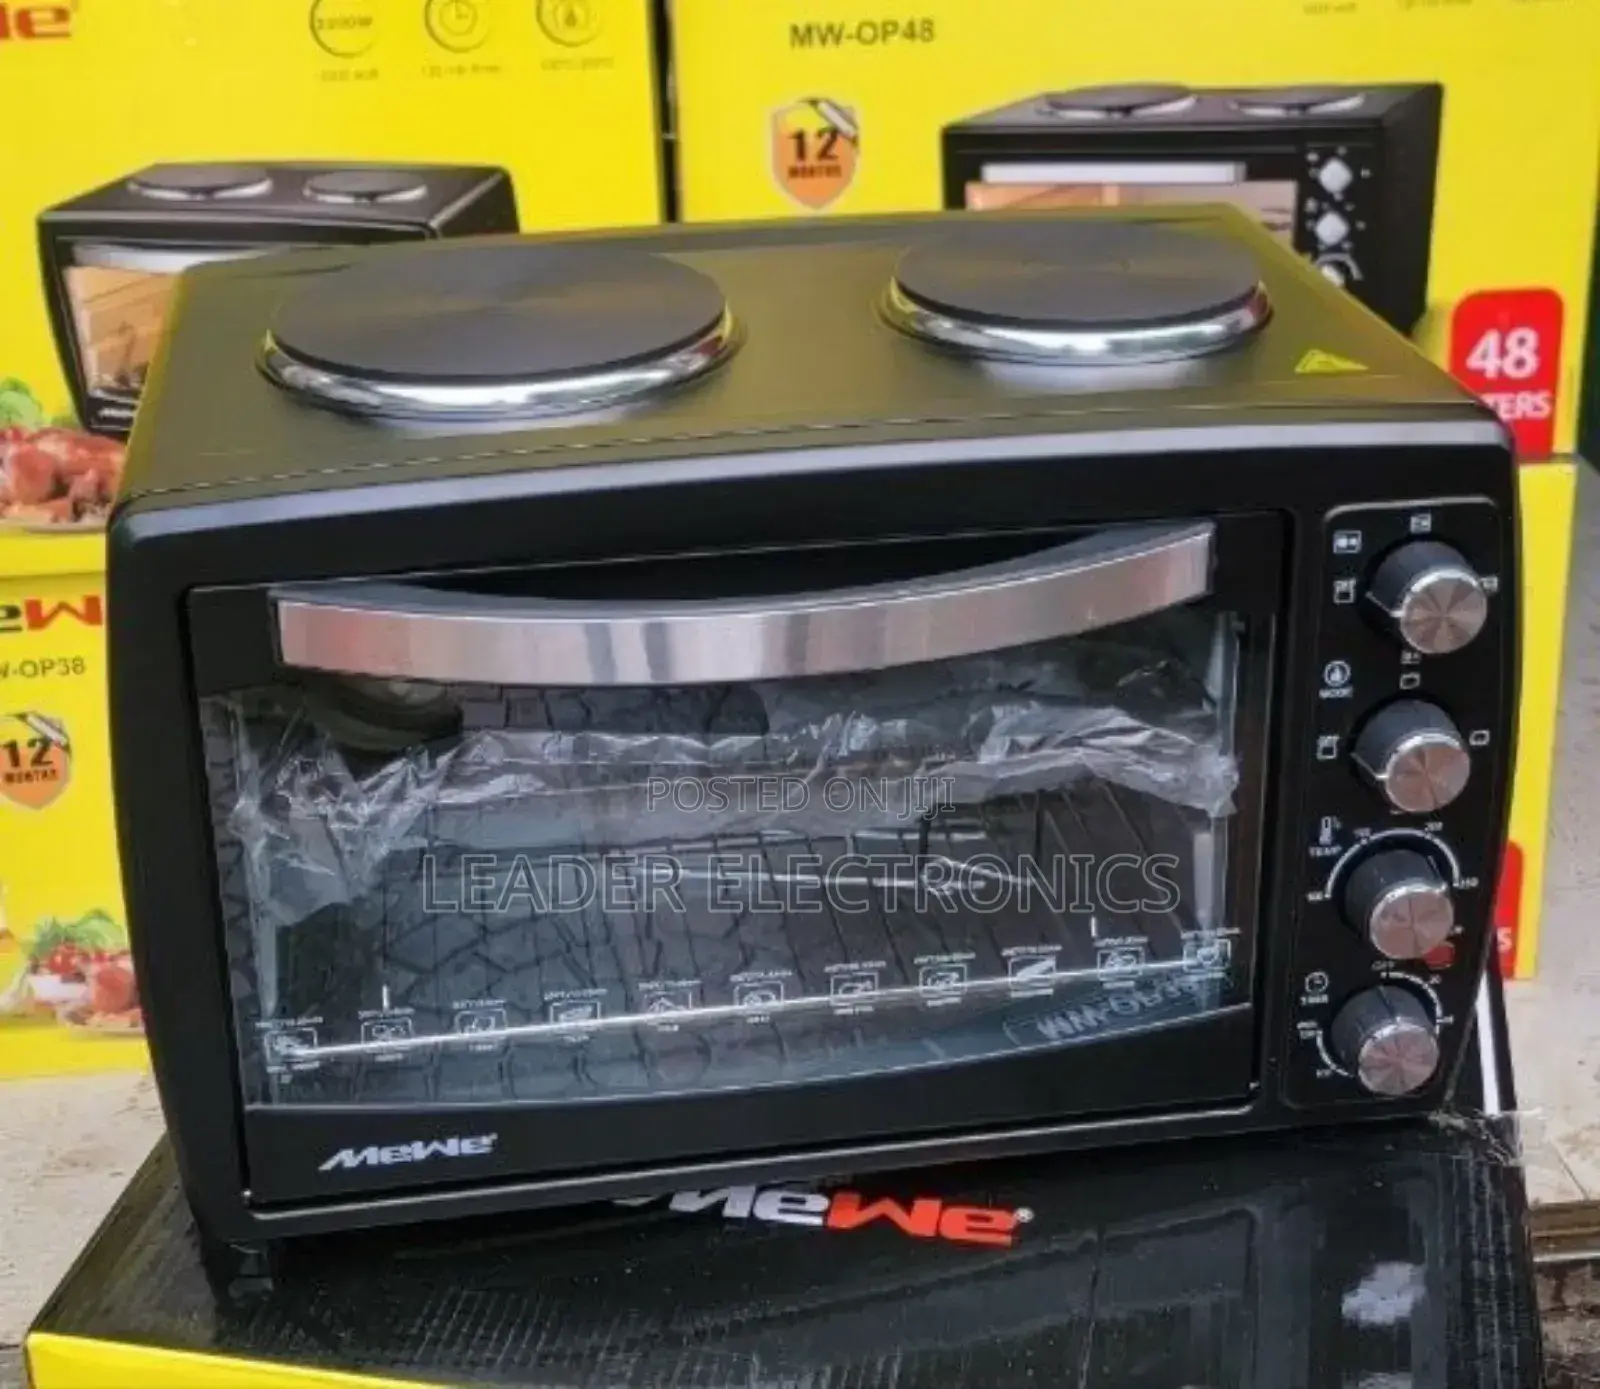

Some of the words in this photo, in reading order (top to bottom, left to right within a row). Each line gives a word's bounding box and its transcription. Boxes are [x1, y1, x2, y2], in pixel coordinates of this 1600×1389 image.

[0, 1, 73, 40] e
[789, 18, 937, 49] MW-OP48
[788, 127, 840, 162] 12
[1464, 326, 1541, 381] 48
[0, 737, 54, 769] 12
[317, 1134, 497, 1172] MeWe
